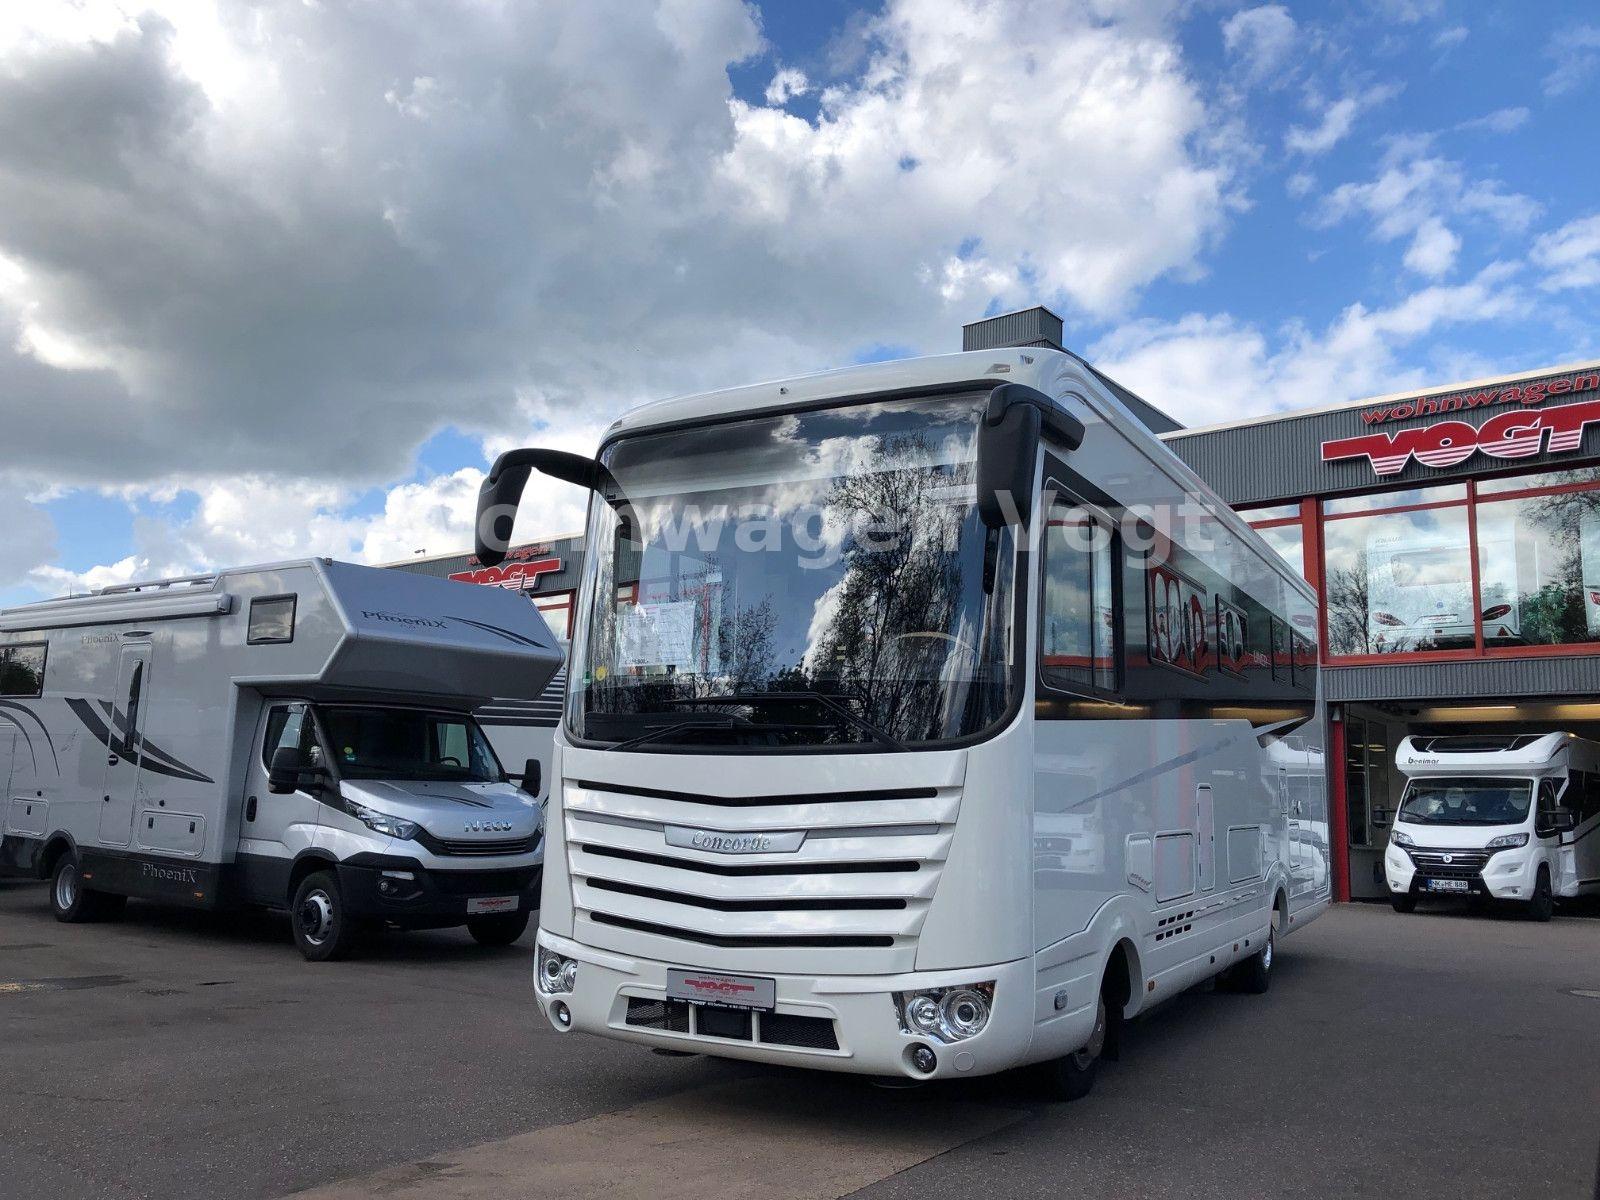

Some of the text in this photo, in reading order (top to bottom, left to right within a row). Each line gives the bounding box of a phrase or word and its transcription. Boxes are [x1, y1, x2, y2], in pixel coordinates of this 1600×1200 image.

[1361, 373, 1600, 425] wohnwagen
[1321, 399, 1600, 476] VOGT
[463, 819, 512, 833] IVECO
[691, 829, 771, 851] Concorde
